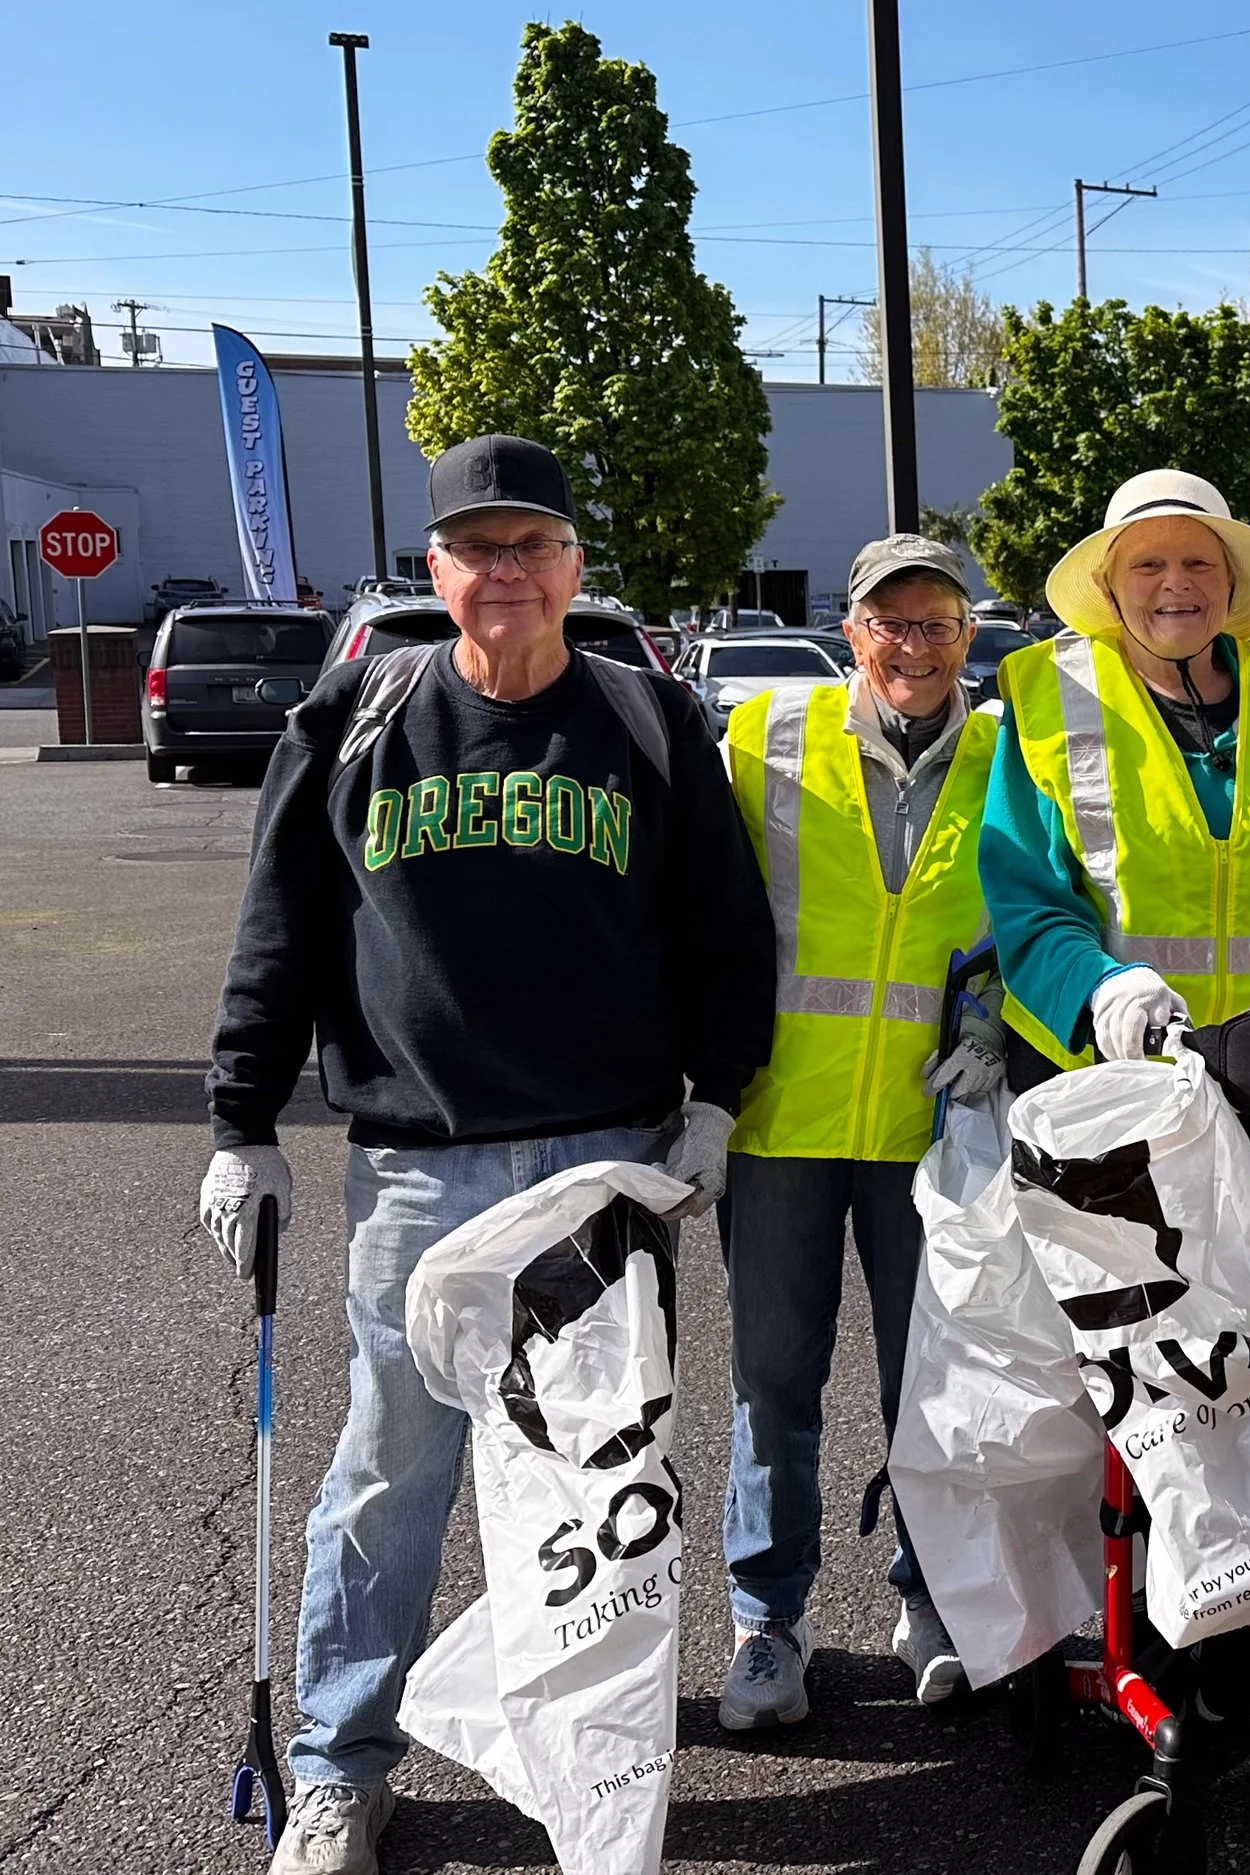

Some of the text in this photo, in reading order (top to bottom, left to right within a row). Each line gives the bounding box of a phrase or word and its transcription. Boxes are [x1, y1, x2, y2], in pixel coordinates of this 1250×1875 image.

[235, 360, 275, 585] GUEST PARKING
[46, 532, 110, 557] STOP
[364, 771, 631, 875] OREGON
[1201, 1576, 1221, 1593] by
[554, 1574, 662, 1650] Taking
[1193, 1600, 1233, 1621] from
[590, 1774, 631, 1799] This
[632, 1758, 667, 1780] bag
